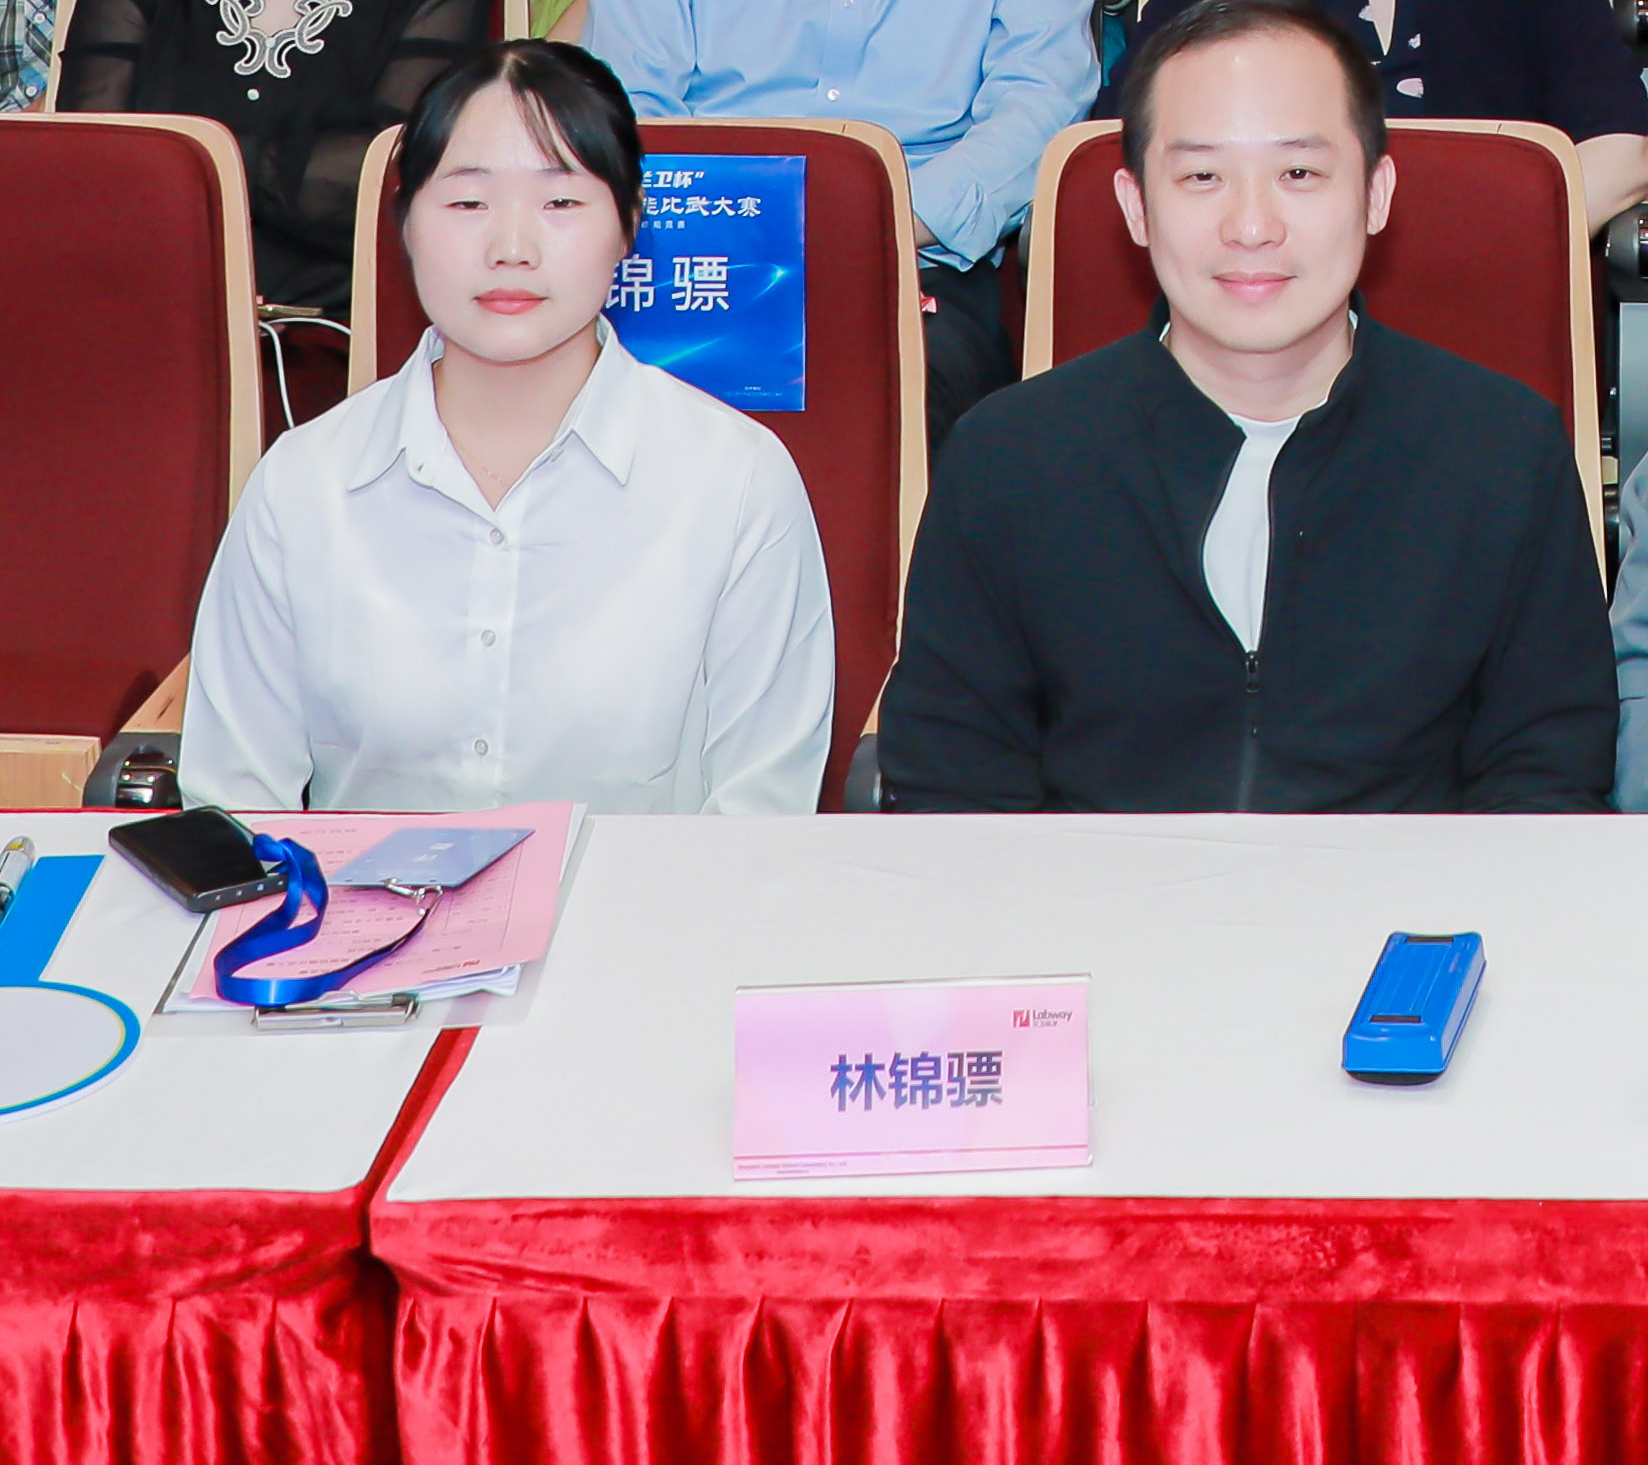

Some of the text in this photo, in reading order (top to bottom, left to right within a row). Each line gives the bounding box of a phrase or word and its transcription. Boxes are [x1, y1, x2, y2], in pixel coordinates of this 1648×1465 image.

[1032, 1009, 1073, 1023] Labway
[830, 1050, 1004, 1113] 林锦骠
